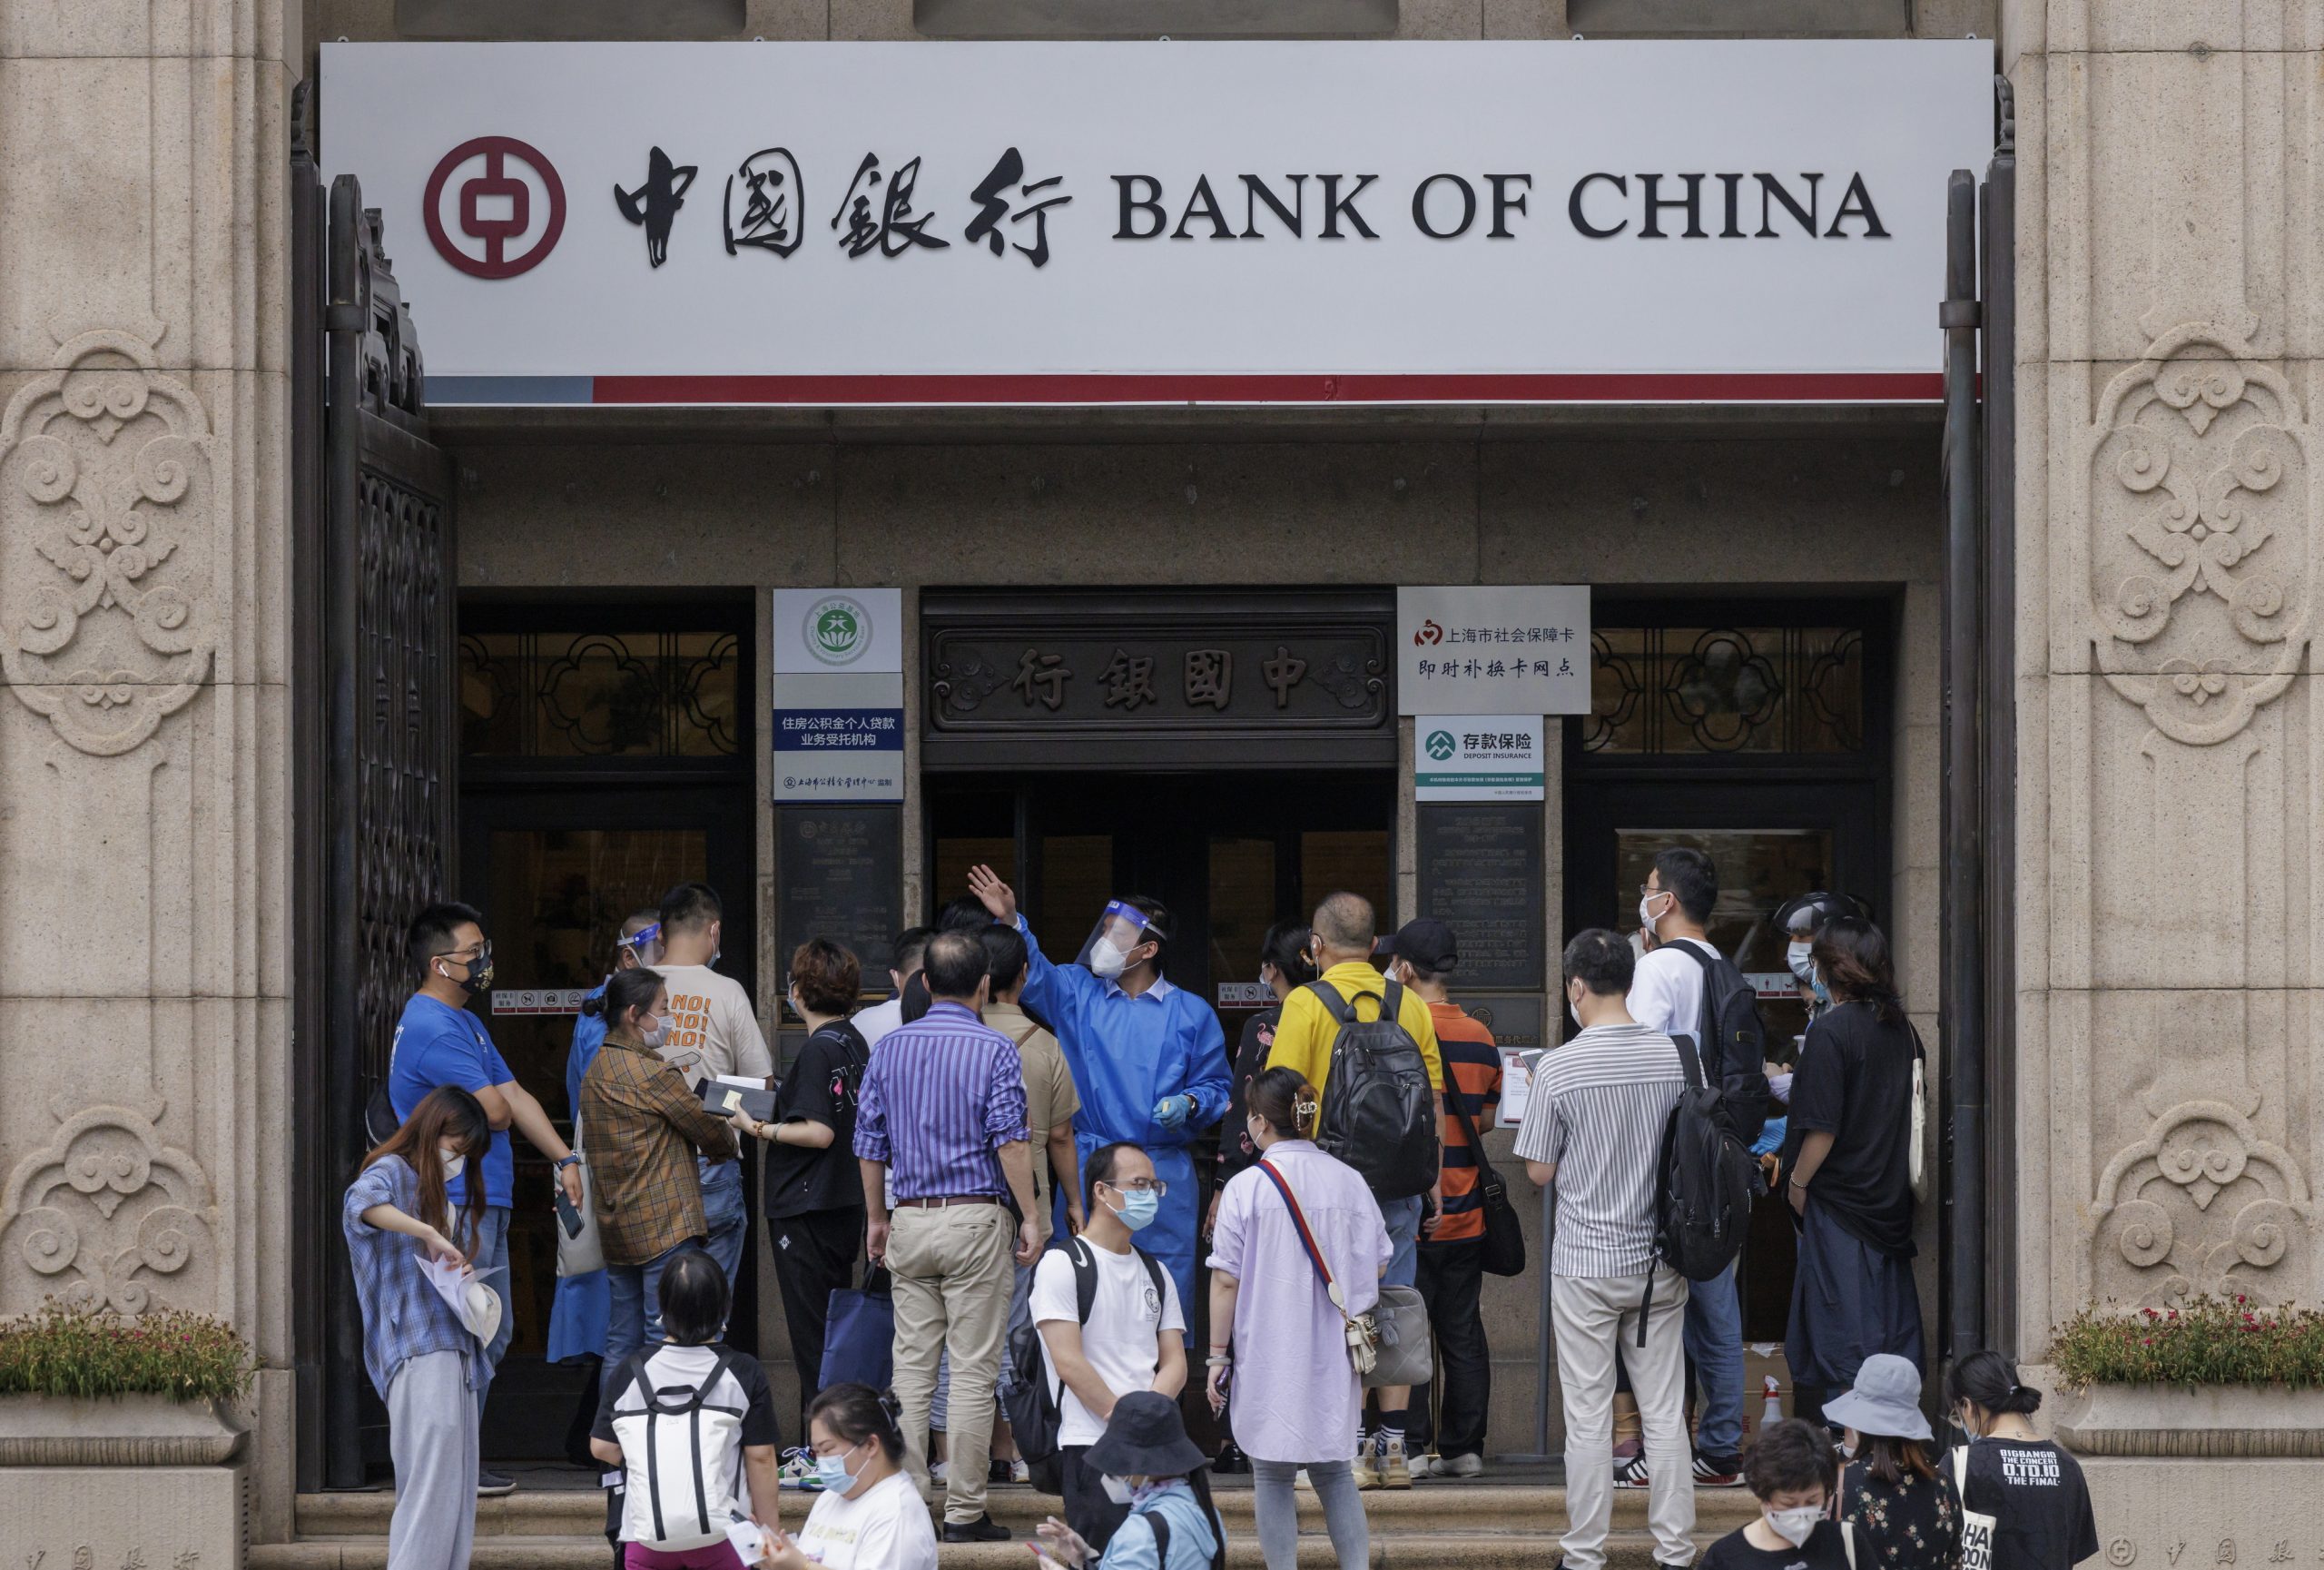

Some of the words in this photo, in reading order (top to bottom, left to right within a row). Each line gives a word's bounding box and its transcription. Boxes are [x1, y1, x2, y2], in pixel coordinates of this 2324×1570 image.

[615, 145, 1073, 269] 中國銀行
[1111, 173, 1380, 240] BANK
[1412, 173, 1532, 240] OF
[1568, 171, 1891, 240] CHINA
[1445, 627, 1575, 644] 上海市社会保障卡
[1418, 658, 1574, 680] 即时补换卡网点
[782, 717, 895, 730] 住房公积金个人贷款
[801, 733, 876, 746] 业务受托机构
[1462, 733, 1532, 750] 存款保险
[672, 994, 712, 1014] NO!
[665, 1030, 706, 1049] NO!
